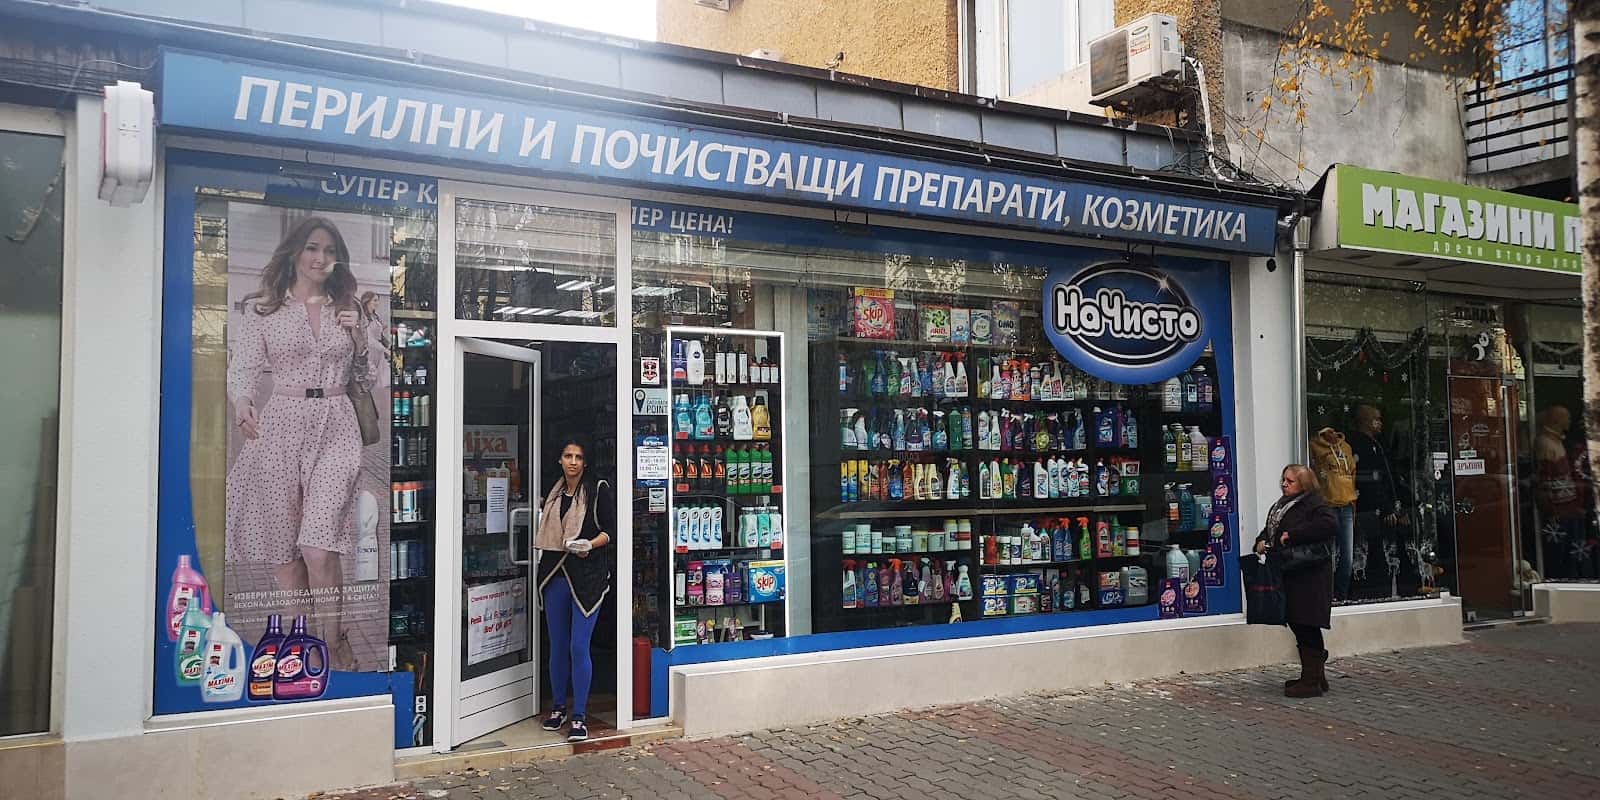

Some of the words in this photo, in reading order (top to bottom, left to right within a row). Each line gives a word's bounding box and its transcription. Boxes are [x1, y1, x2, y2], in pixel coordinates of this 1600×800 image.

[234, 75, 504, 153] ПЕРИЛНИ
[519, 118, 557, 160] И
[570, 124, 864, 201] ПОЧИСТВАЩИ
[874, 166, 1070, 227] ПРЕПАРАТИ,
[1082, 194, 1247, 243] КОЗМЕТИКА
[320, 173, 409, 201] СУПЕР
[417, 183, 438, 204] К
[670, 210, 734, 234] ЦЕНА!
[1362, 183, 1556, 251] МАГАЗИНИ
[1055, 285, 1199, 340] НаЧисто
[647, 405, 668, 414] POINT
[234, 591, 267, 601] ИЗБЕРИ
[269, 586, 340, 599] НЕПОБЕДИМАТА
[208, 676, 234, 687] MAXIMA
